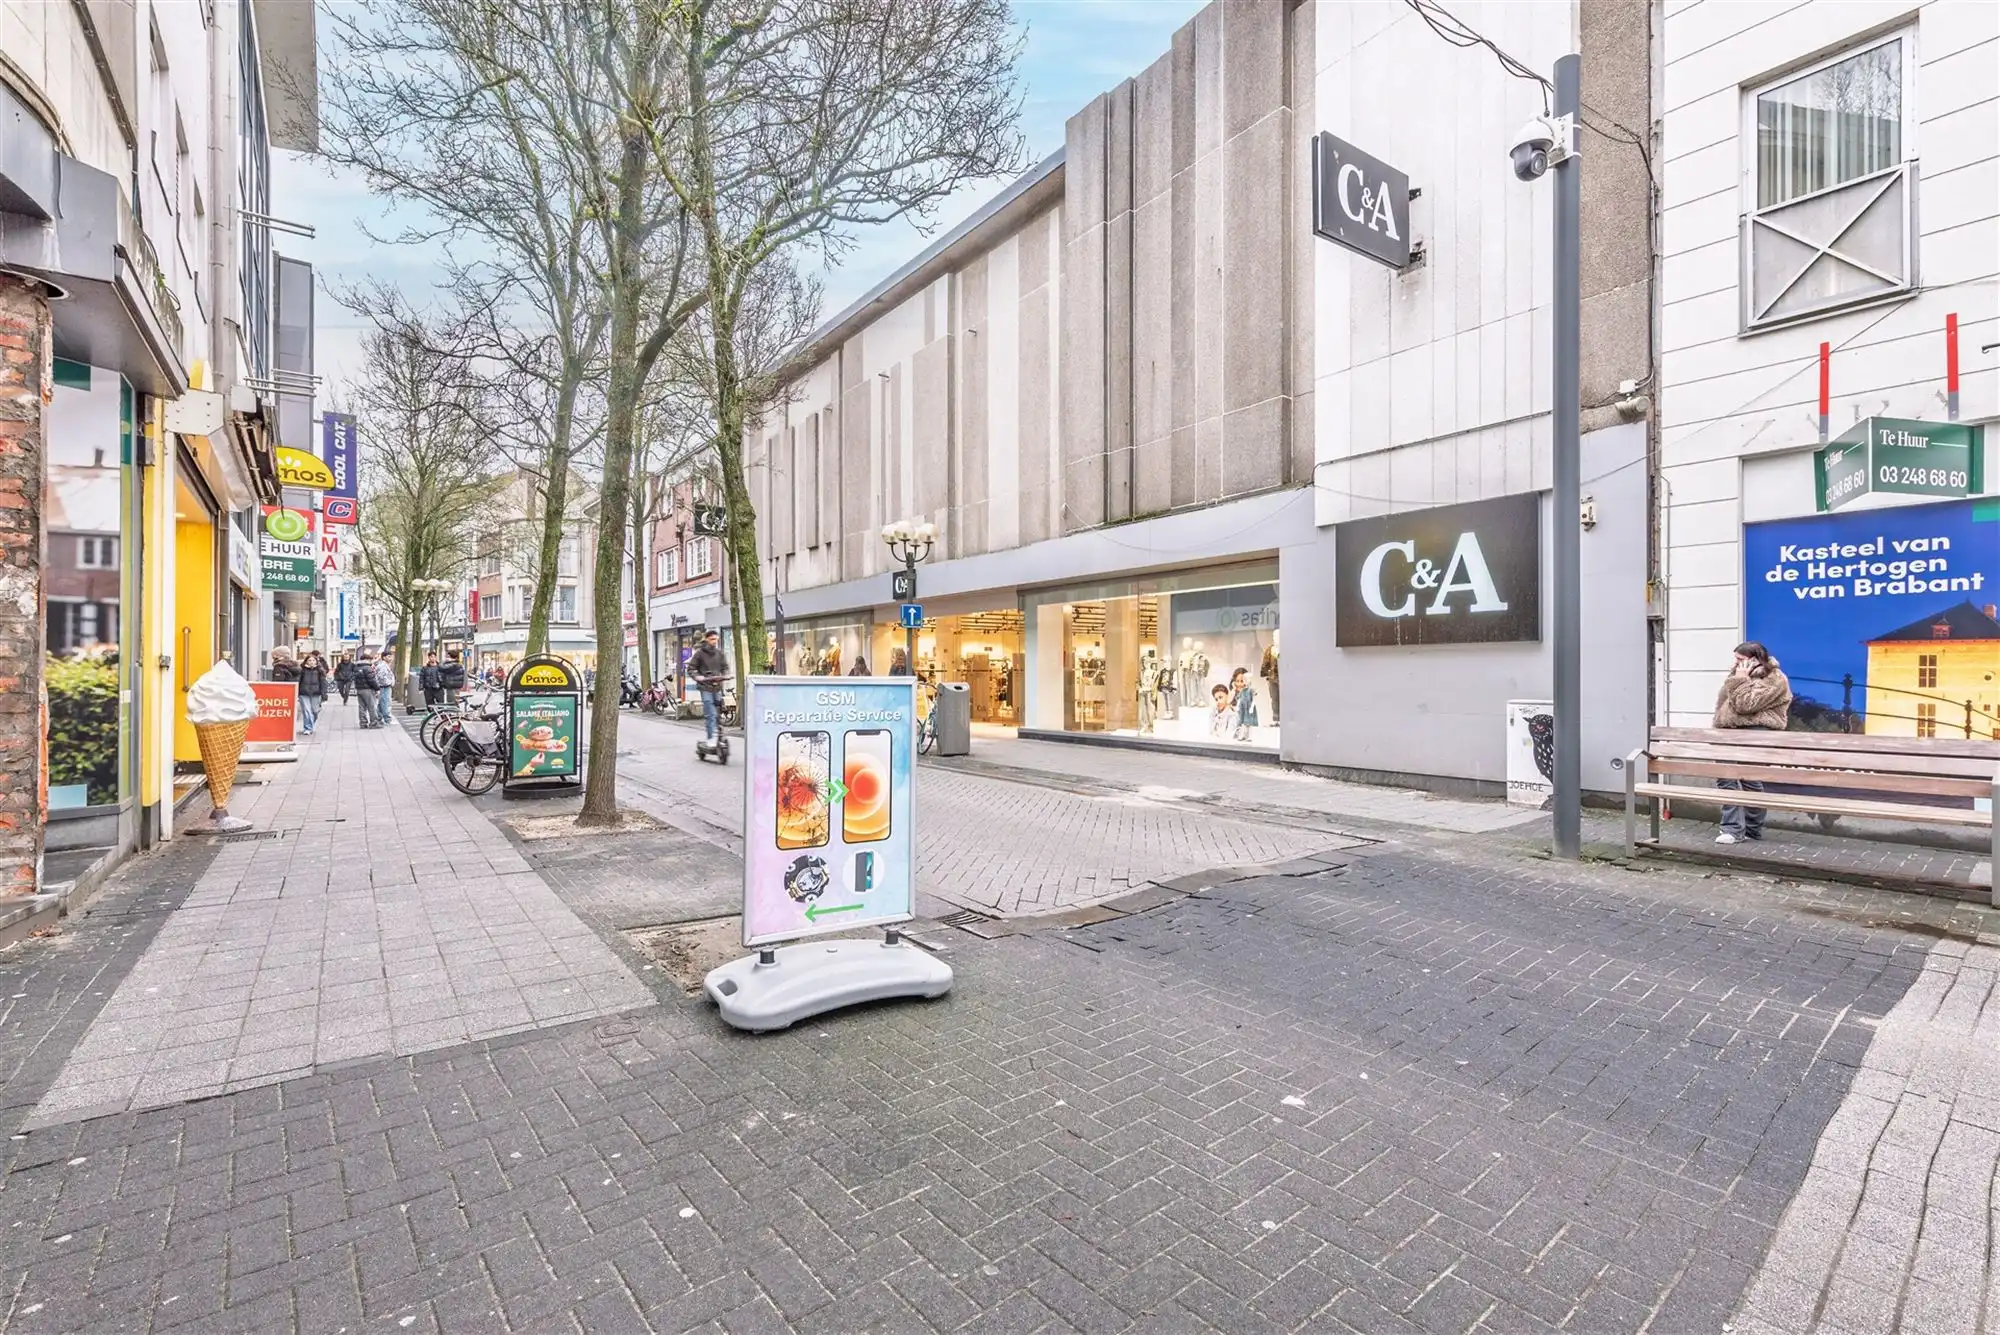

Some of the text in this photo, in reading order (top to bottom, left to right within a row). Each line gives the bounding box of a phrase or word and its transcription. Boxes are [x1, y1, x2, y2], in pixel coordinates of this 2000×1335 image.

[1338, 163, 1400, 241] C&A
[1880, 429, 1929, 449] Te Huur
[279, 467, 327, 483] nos
[335, 454, 346, 490] COOL
[1844, 475, 1853, 494] 68
[1854, 468, 1865, 488] 60
[1880, 465, 1967, 488] 03 248 68 60
[271, 543, 311, 556] HUUR
[1780, 536, 1950, 563] Kasteel van
[261, 559, 294, 571] BRE
[1360, 531, 1509, 618] C&A
[1765, 557, 1947, 583] de Hertogen
[266, 573, 284, 581] 248
[285, 574, 297, 582] 68
[298, 575, 310, 583] 60
[1793, 572, 1985, 600] van Brabant
[526, 675, 564, 684] Panos
[815, 691, 856, 706] GSM
[763, 708, 902, 725] Reparatie Service
